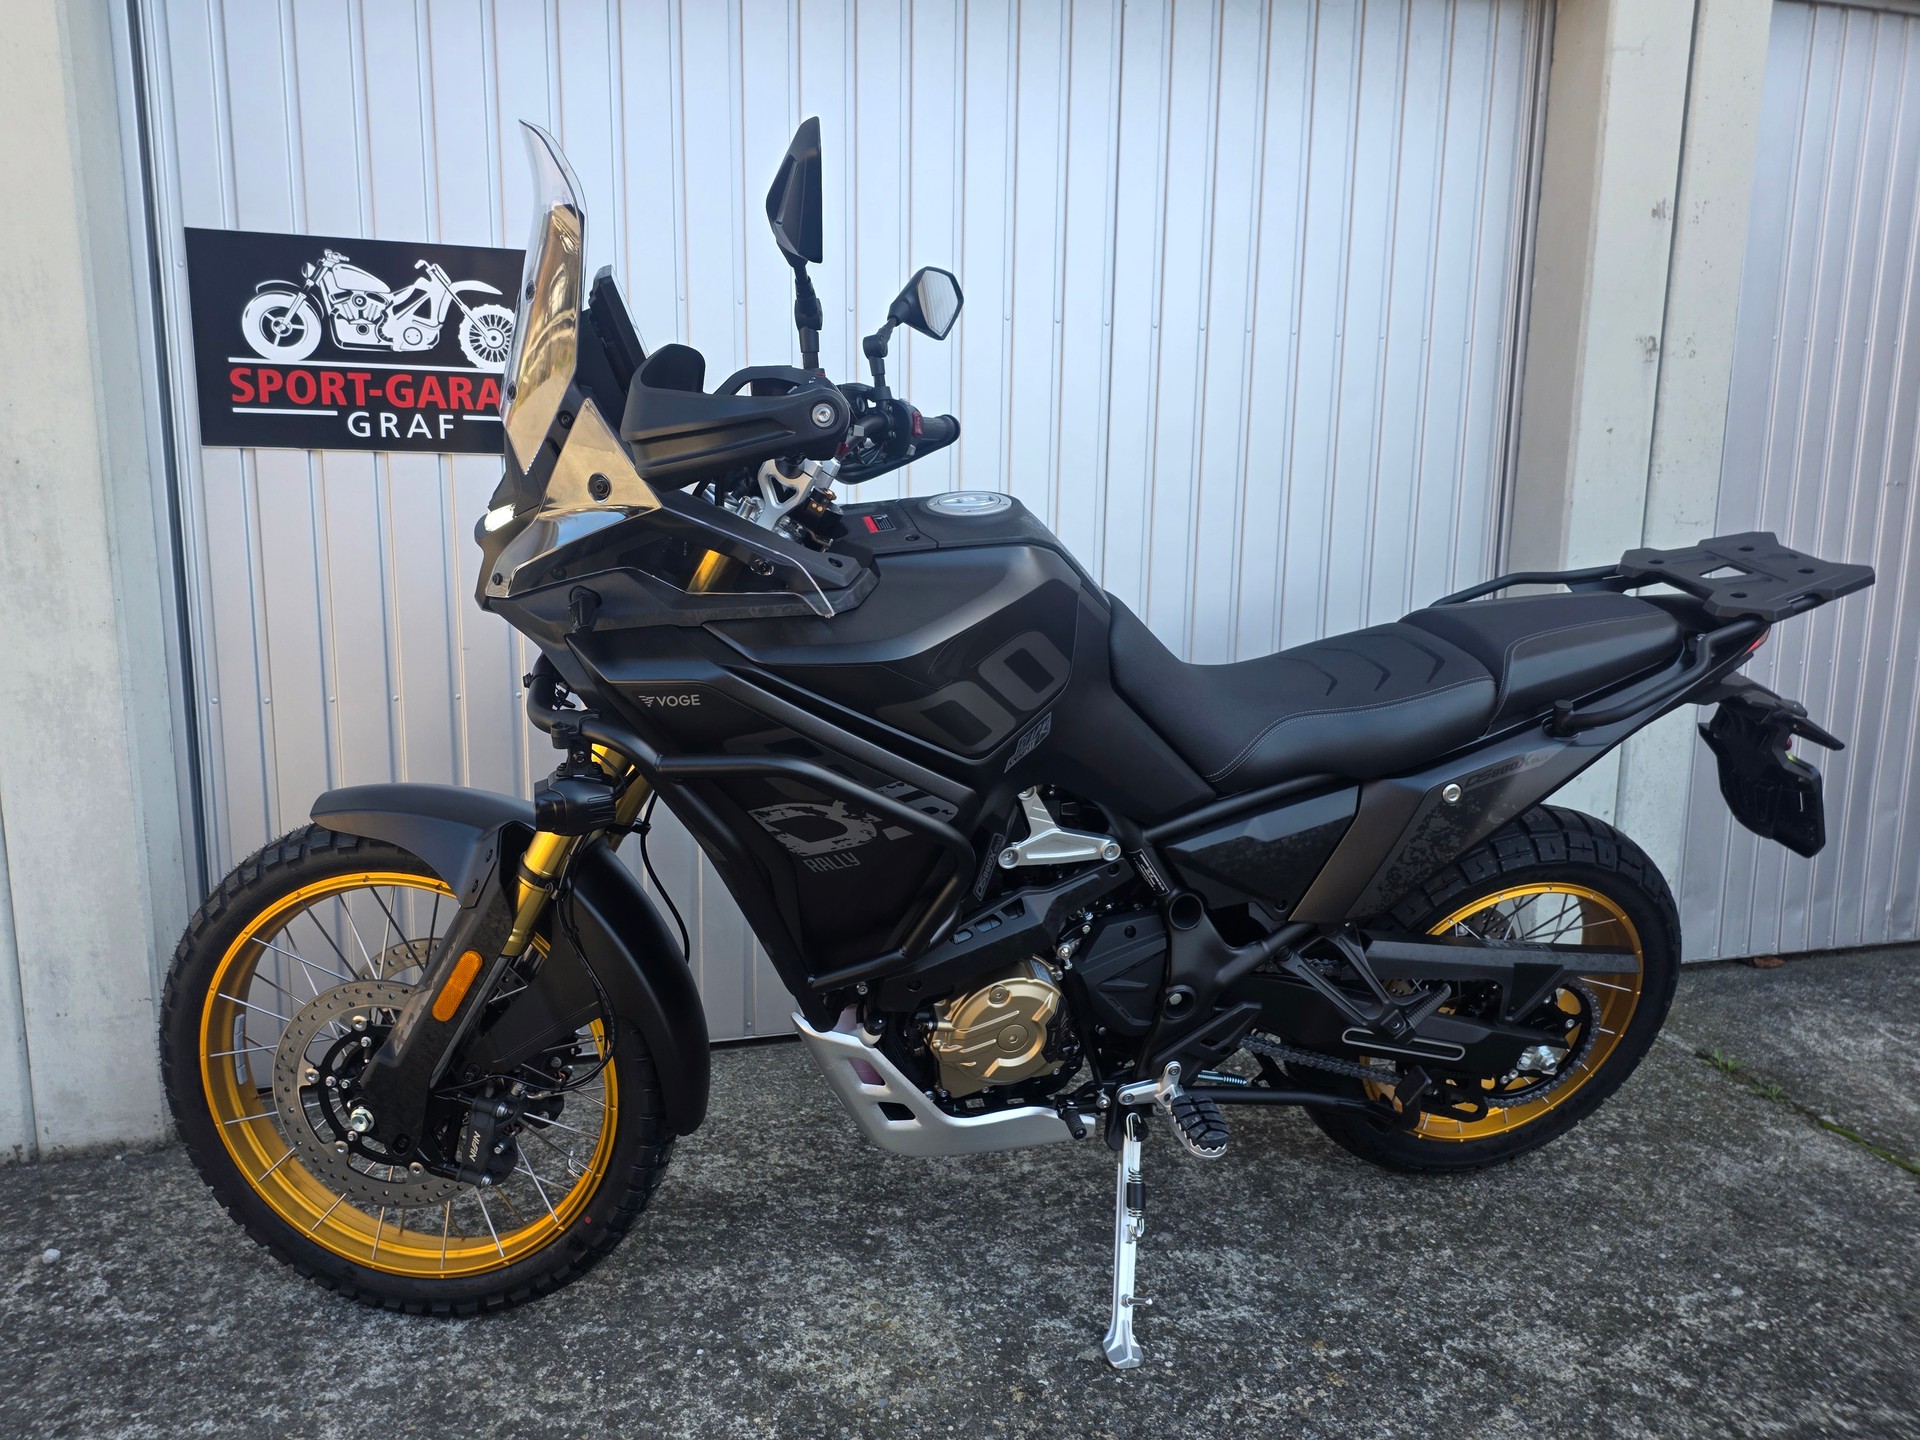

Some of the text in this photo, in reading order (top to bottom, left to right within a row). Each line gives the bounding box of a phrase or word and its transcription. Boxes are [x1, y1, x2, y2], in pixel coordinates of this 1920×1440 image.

[229, 367, 501, 411] SPORT-GARA
[347, 411, 455, 440] GRAF
[655, 694, 702, 708] VOGE
[802, 851, 862, 873] RALLY
